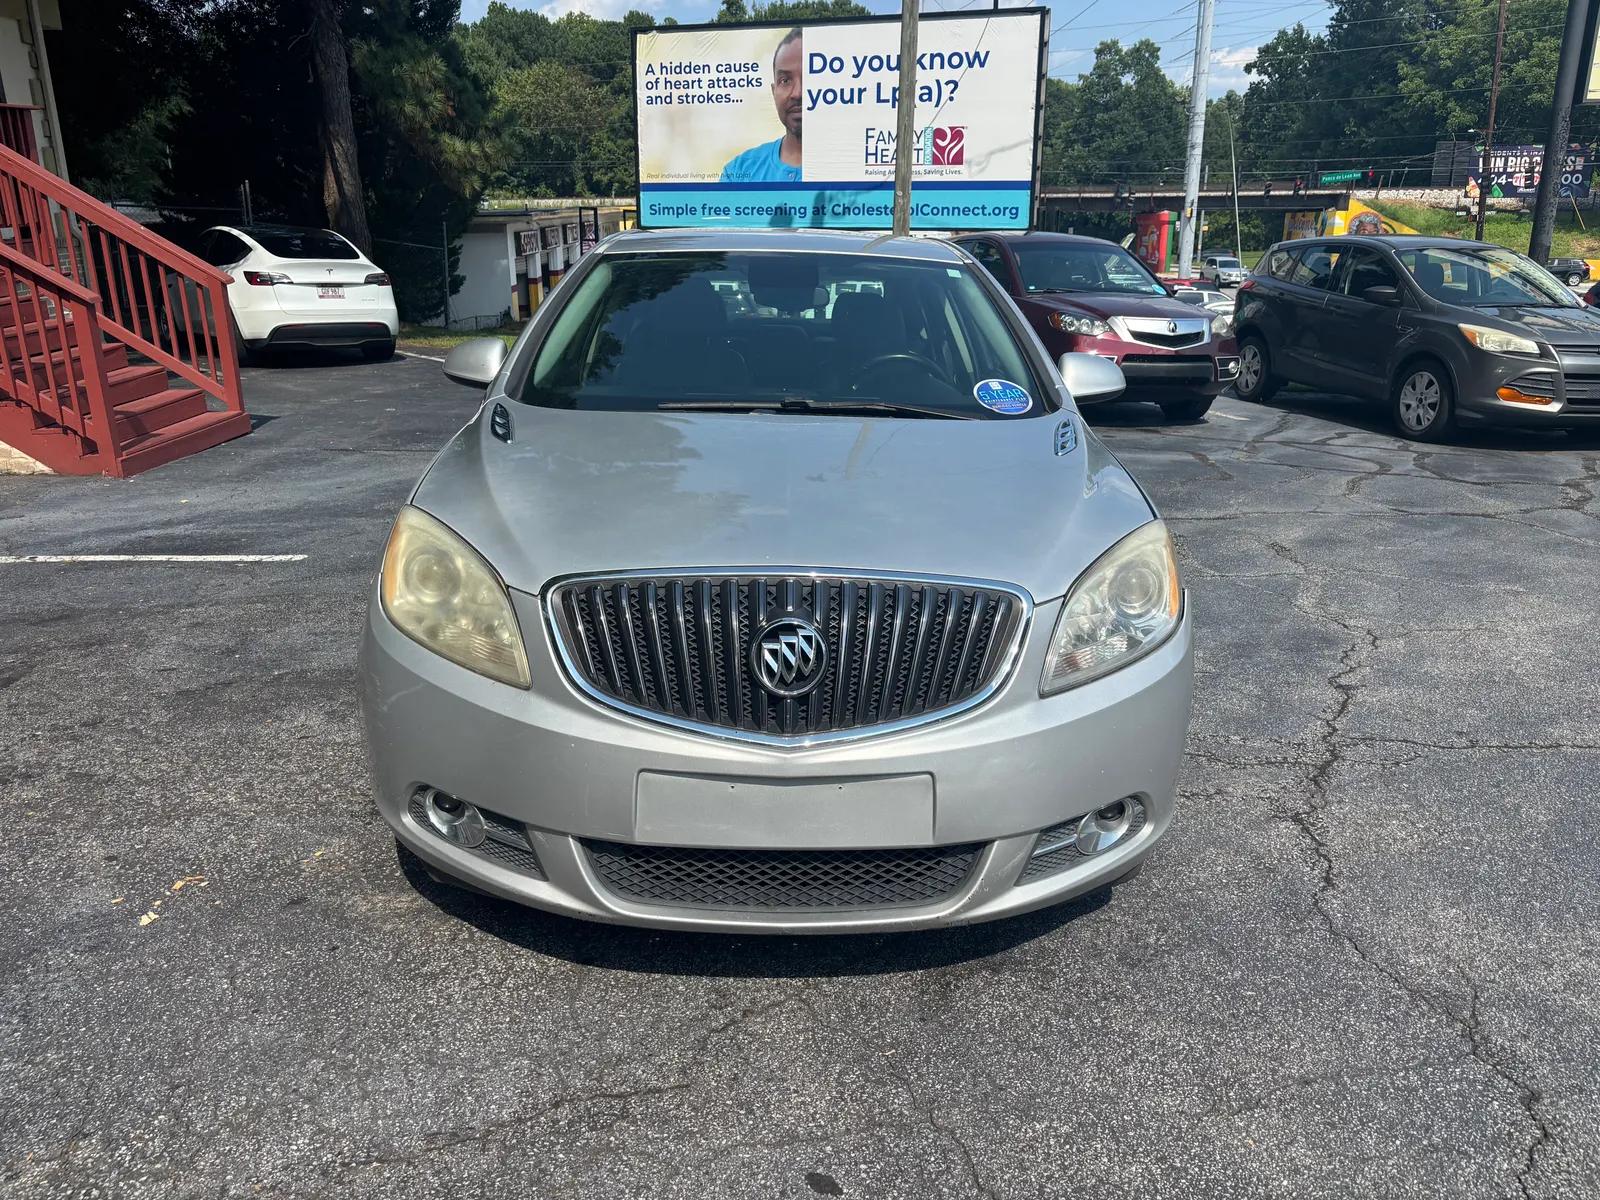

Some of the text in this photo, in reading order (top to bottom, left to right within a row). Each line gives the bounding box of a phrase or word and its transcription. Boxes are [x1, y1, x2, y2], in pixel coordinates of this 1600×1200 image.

[645, 61, 760, 76] A hidden cause
[808, 52, 845, 75] Do
[851, 54, 901, 79] you
[645, 74, 763, 91] of heart attacks
[646, 90, 743, 105] and strokes...
[806, 86, 867, 112] your
[646, 172, 660, 180] Real
[690, 171, 706, 180] living
[865, 169, 887, 177] Raising
[923, 168, 944, 176] Saving
[649, 202, 1020, 220] Simple free screening at CholesteolConnect.org
[979, 388, 1024, 400] 5 YEAR
